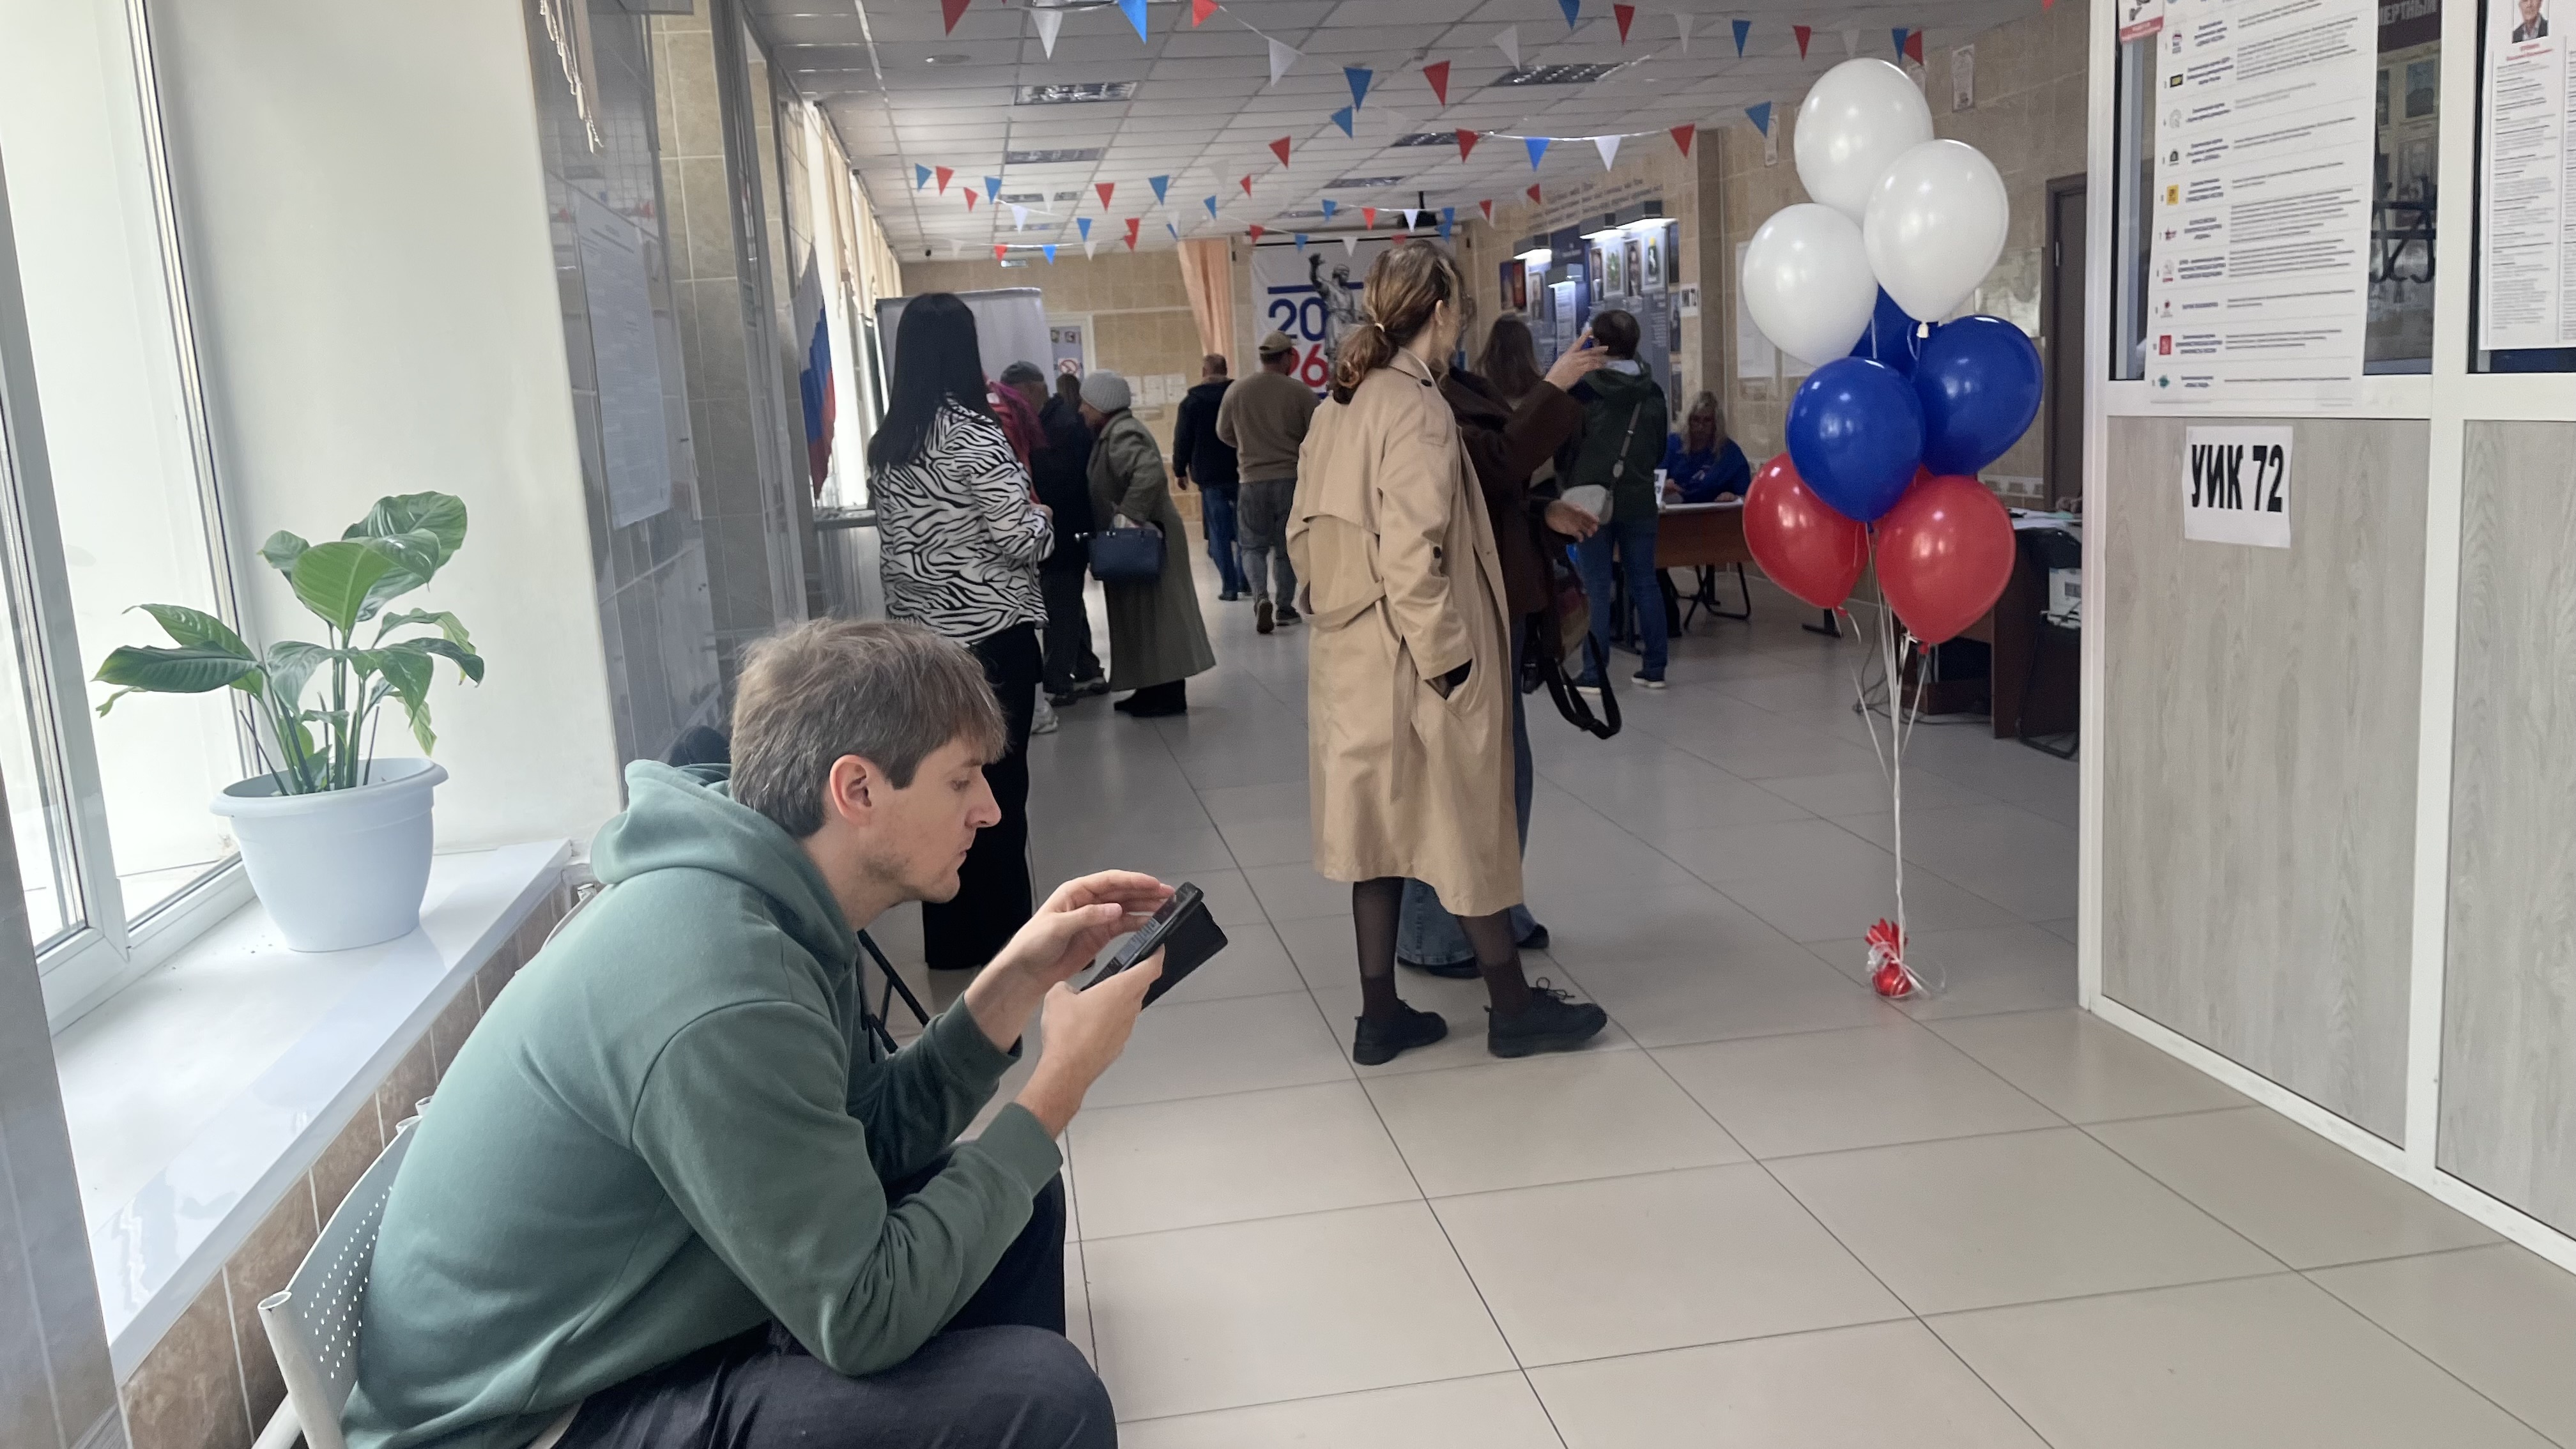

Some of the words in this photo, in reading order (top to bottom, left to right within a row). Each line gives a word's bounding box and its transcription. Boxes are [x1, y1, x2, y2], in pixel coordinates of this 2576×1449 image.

[1268, 296, 1328, 341] 20
[2191, 444, 2243, 510] УИК
[2253, 444, 2284, 512] 72
